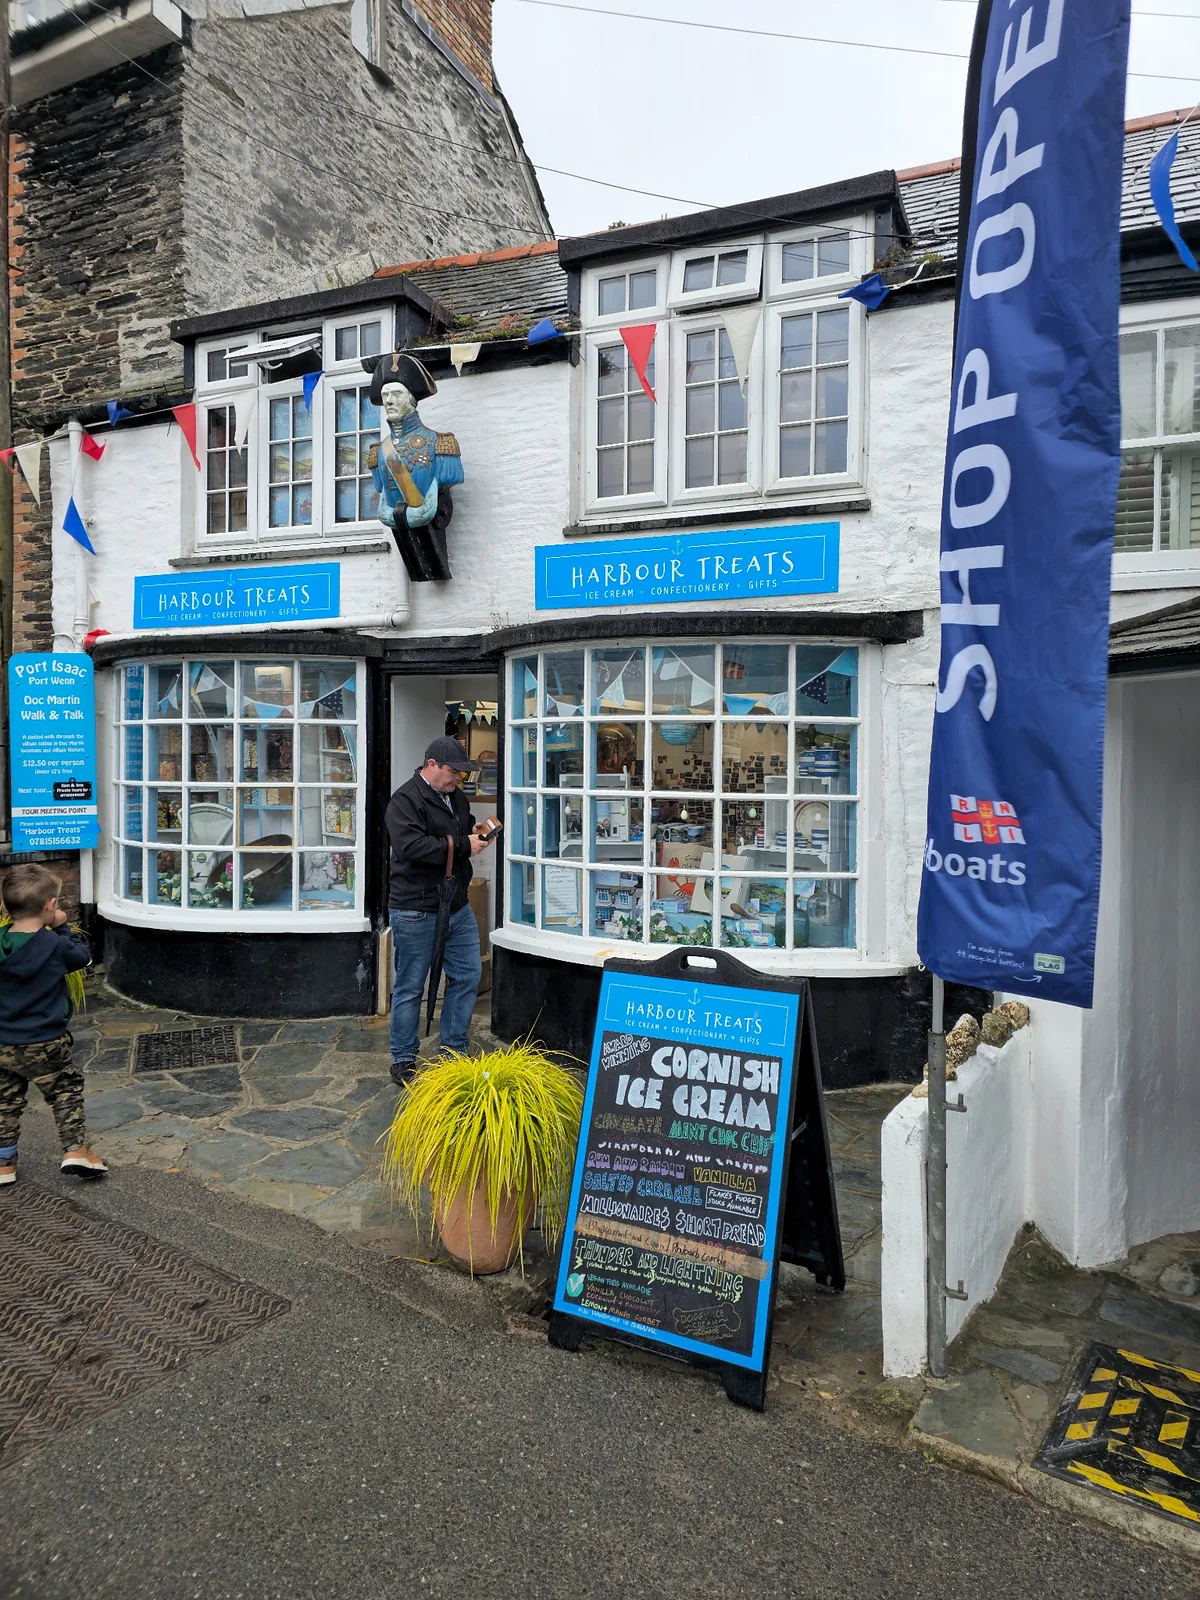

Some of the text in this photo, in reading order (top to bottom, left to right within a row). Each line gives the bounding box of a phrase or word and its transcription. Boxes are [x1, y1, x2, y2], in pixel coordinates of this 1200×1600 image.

[936, 0, 1065, 722] SHOP OPE
[572, 551, 794, 589] HARBOUR TREATS
[158, 584, 310, 612] HARBOUR TREATS
[585, 578, 778, 600] ICE CREAM CONFECTIONERY GIFTS
[180, 613, 201, 621] CREAM
[212, 609, 267, 619] CONFECTIONERY
[278, 607, 300, 616] GIFTS
[15, 660, 87, 678] Port Isaac
[28, 676, 75, 684] Port Wenn
[24, 694, 80, 705] Doc Martin
[20, 710, 84, 720] Walk & Talk
[30, 836, 80, 846] 07815156632
[925, 838, 1026, 886] boats
[968, 954, 997, 964] recycled
[999, 959, 1024, 969] bottles!
[998, 948, 1014, 957] from
[1038, 962, 1060, 970] FLAG
[626, 1001, 762, 1034] HARBOUR TREATS
[638, 1022, 660, 1030] CREAM
[672, 1026, 727, 1040] CONFECTIONERY
[740, 1036, 760, 1046] GIFTS
[600, 1037, 651, 1070] WINNING
[603, 1034, 634, 1056] AWARD
[651, 1046, 780, 1095] CORNISH
[616, 1074, 772, 1132] ICE CREAM
[668, 1120, 707, 1140] MINT
[708, 1126, 738, 1149] CHOC
[586, 1150, 686, 1180] RUM AND RAISIN
[584, 1170, 703, 1206] SALTED CARAMEL
[693, 1166, 757, 1192] VANILLA
[726, 1204, 757, 1215] AVAILABLE
[735, 1194, 757, 1205] FUDGE
[672, 1242, 700, 1258] Rhubarb
[575, 1238, 744, 1294] THUNDER AND LIGHTNING
[586, 1274, 653, 1296] VEGAN TUBS AVAILABLE
[620, 1292, 656, 1306] CHOCOLATE
[578, 1306, 588, 1314] ALSO
[592, 1310, 620, 1324] HANDMADE
[608, 1306, 631, 1319] MANGO
[635, 1314, 661, 1327] SORBET
[680, 1310, 724, 1324] DOGGY ICE
[692, 1320, 718, 1328] CREAM
